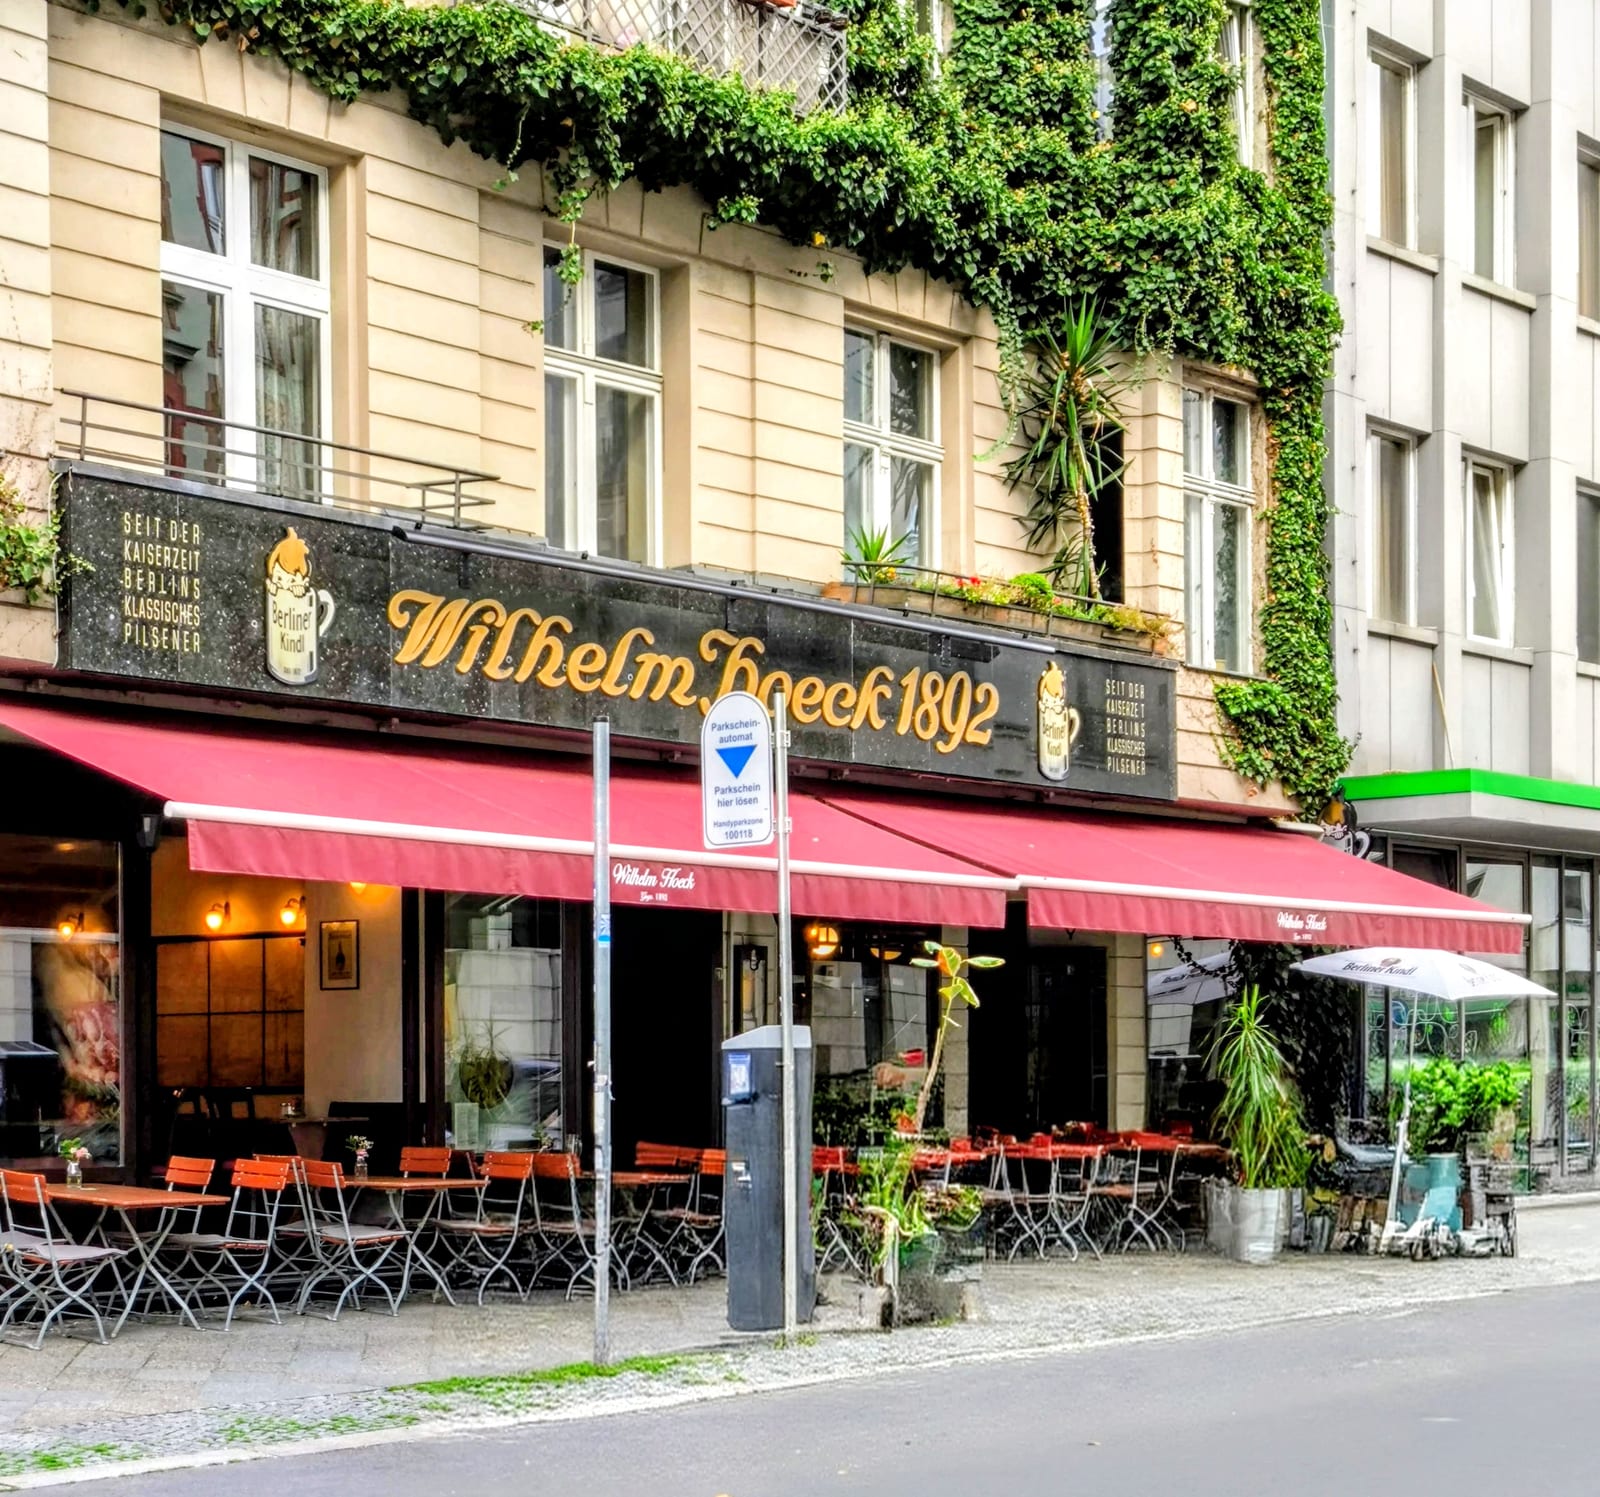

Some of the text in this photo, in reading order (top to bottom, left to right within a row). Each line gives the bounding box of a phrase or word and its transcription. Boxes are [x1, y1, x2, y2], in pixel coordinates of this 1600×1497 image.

[123, 511, 200, 545] SEIT DER
[123, 540, 200, 572] KAISERZEIT
[123, 567, 200, 600] BERLINS
[123, 595, 200, 627] KLASSISCHES
[272, 600, 312, 631] Berliner
[123, 622, 200, 653] PILSENER
[280, 632, 305, 653] Kindl
[387, 588, 1001, 756] Wilhelm Hoeck 1892
[1105, 678, 1145, 699] SEIT DER
[1105, 698, 1145, 719] KAISERZET
[711, 719, 761, 732] Parkschein-
[1106, 717, 1146, 738] BERLINS
[718, 732, 753, 744] automat
[1107, 756, 1146, 776] PILSENER
[714, 783, 761, 795] Parkschein
[717, 796, 759, 808] hier lösen
[713, 818, 764, 829] Handyparkzone
[724, 829, 753, 840] 100118
[1342, 961, 1419, 976] Berliner Kindl
